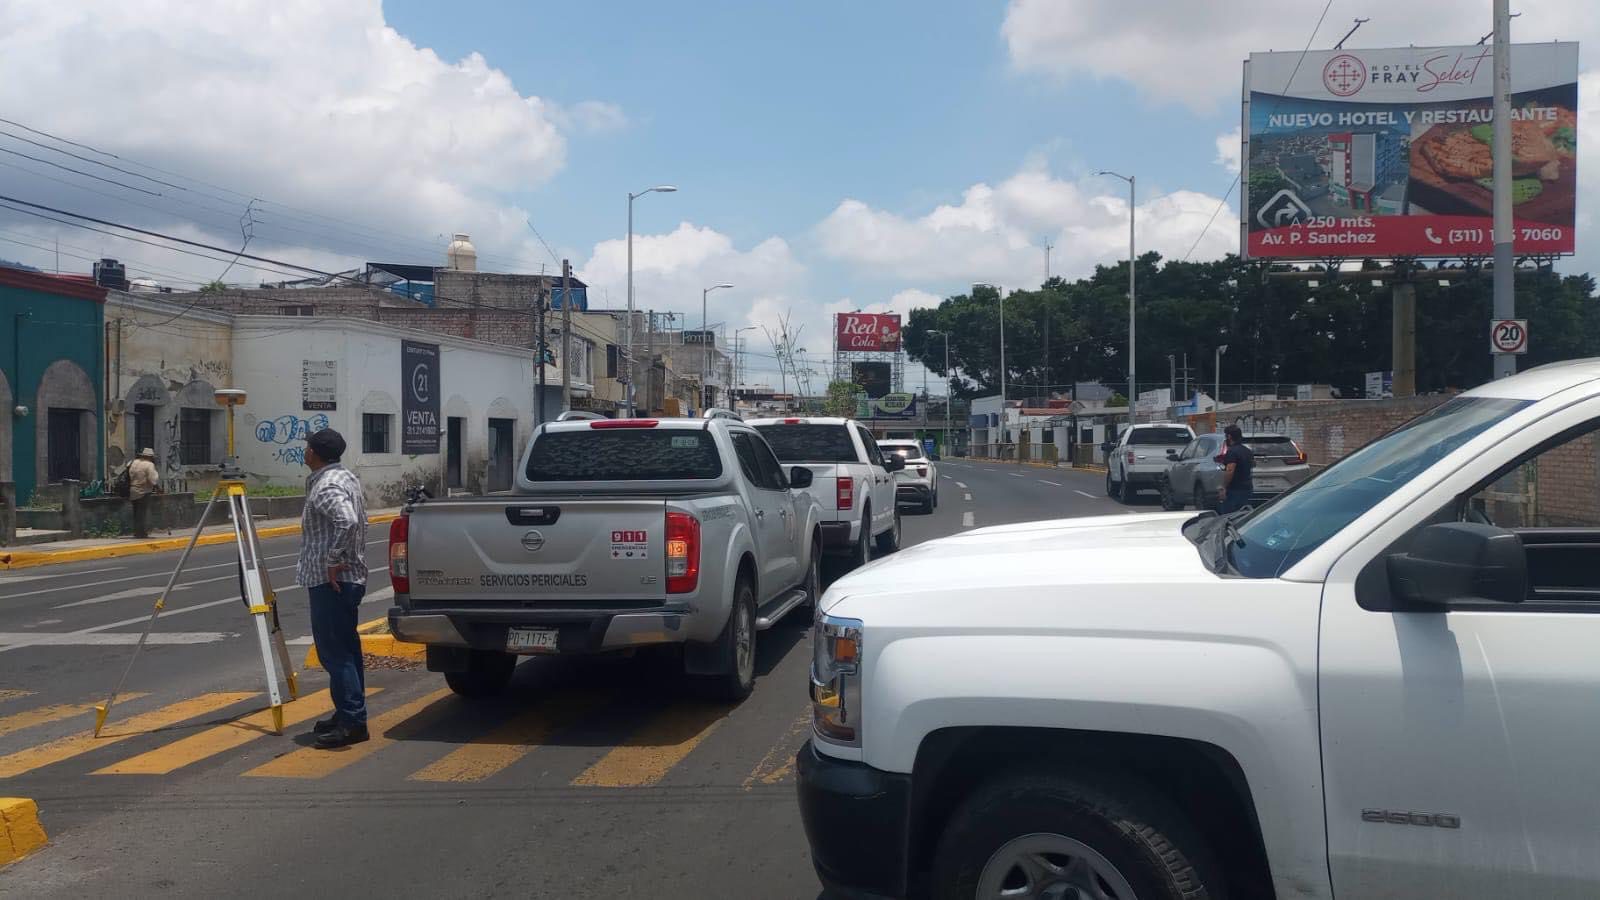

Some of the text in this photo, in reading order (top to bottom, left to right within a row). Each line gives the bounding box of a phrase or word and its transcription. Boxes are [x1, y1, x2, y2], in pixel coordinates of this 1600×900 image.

[1371, 47, 1494, 93] FRAY Select
[1269, 107, 1558, 128] NUEVO HOTEL Y RESTAUANTE
[1307, 215, 1336, 229] 250
[1340, 216, 1376, 228] mts.
[1261, 231, 1376, 245] Av. P. Sanchez
[1448, 229, 1483, 244] (311)
[1521, 228, 1562, 241] 7060
[841, 315, 878, 335] Red
[1500, 325, 1520, 341] 20
[851, 335, 875, 347] Cola
[406, 410, 436, 425] VENTA
[613, 532, 645, 541] 911
[480, 575, 587, 587] SERVICIOS PERICIALES
[1361, 808, 1461, 829] 2500
